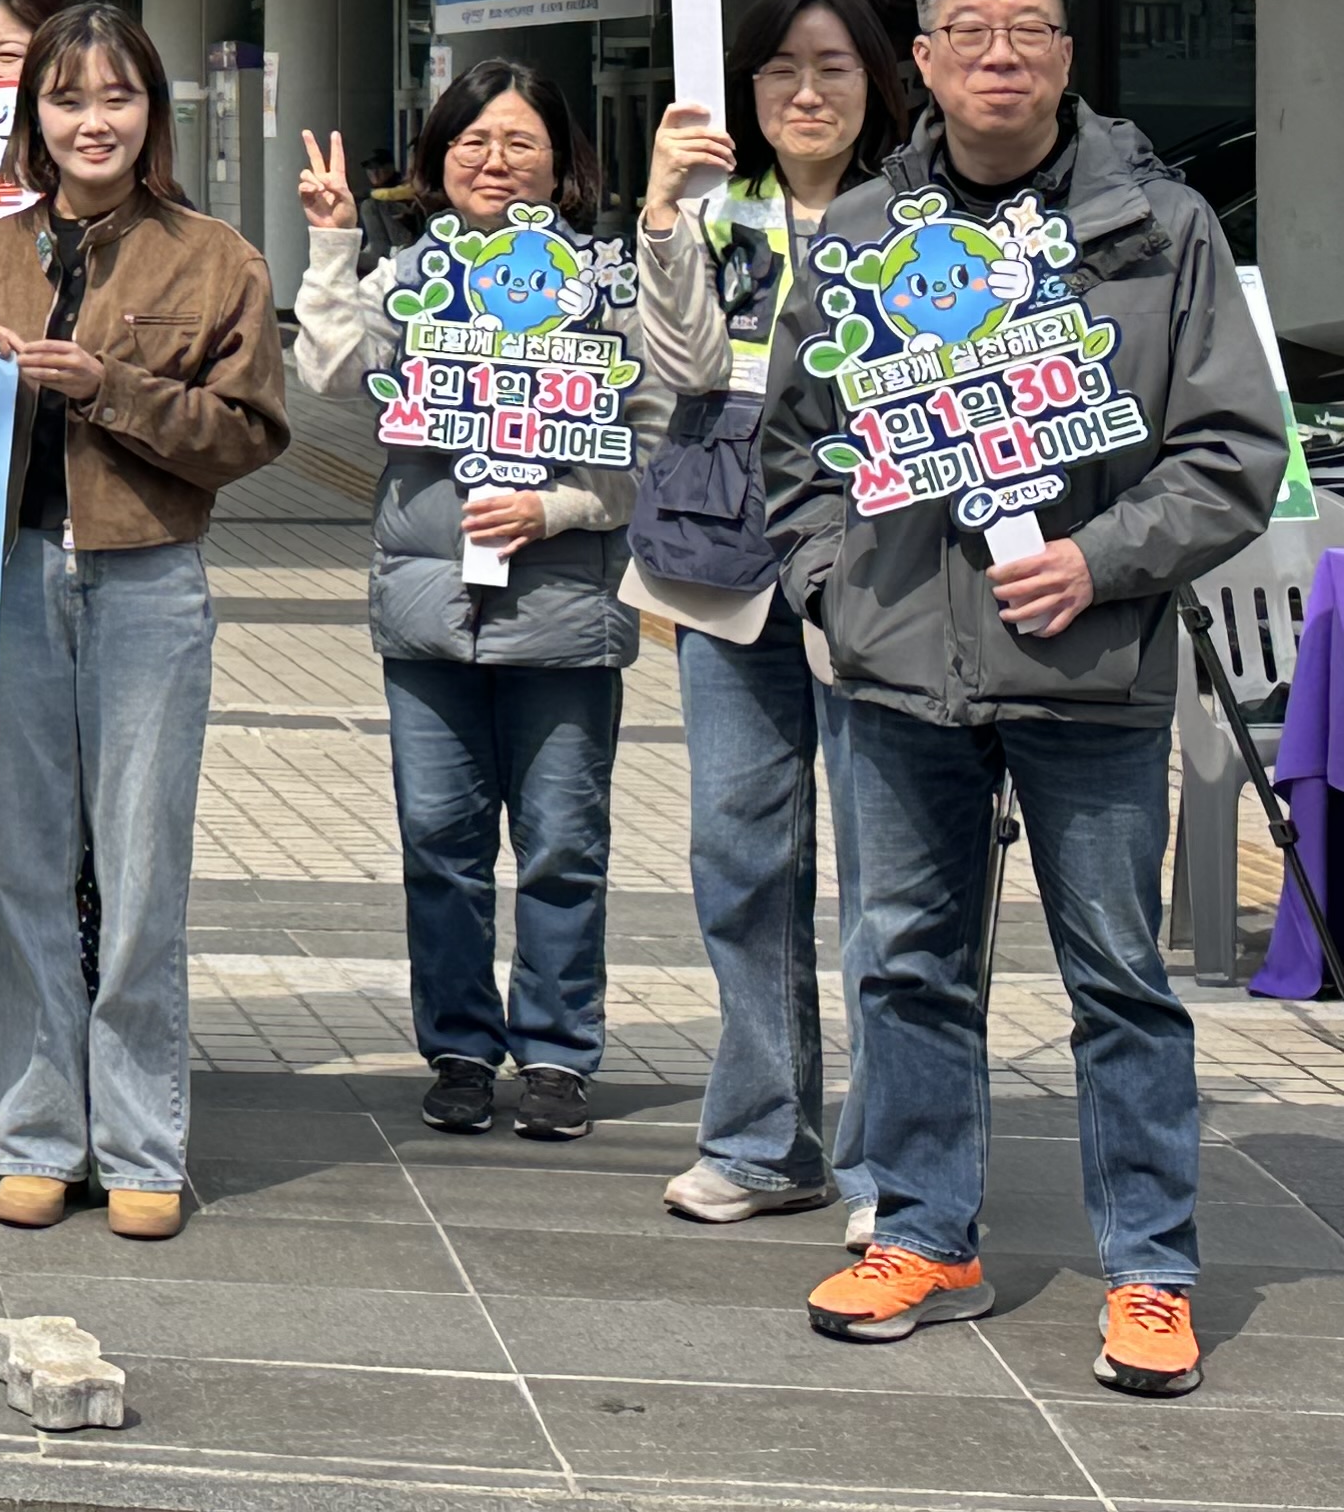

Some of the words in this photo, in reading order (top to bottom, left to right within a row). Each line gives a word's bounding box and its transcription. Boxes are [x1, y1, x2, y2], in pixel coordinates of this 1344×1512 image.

[406, 364, 460, 402] 1인
[472, 367, 526, 406] 1일
[539, 371, 615, 418] 30g
[853, 356, 943, 400] 다함께
[855, 409, 925, 454] 1인
[932, 386, 1008, 432] 1일
[1008, 359, 1107, 414] 30g
[383, 401, 486, 450] 쓰레기
[496, 411, 627, 462] 다이어트
[852, 445, 980, 512] 쓰레기
[980, 403, 1143, 476] 다이어트
